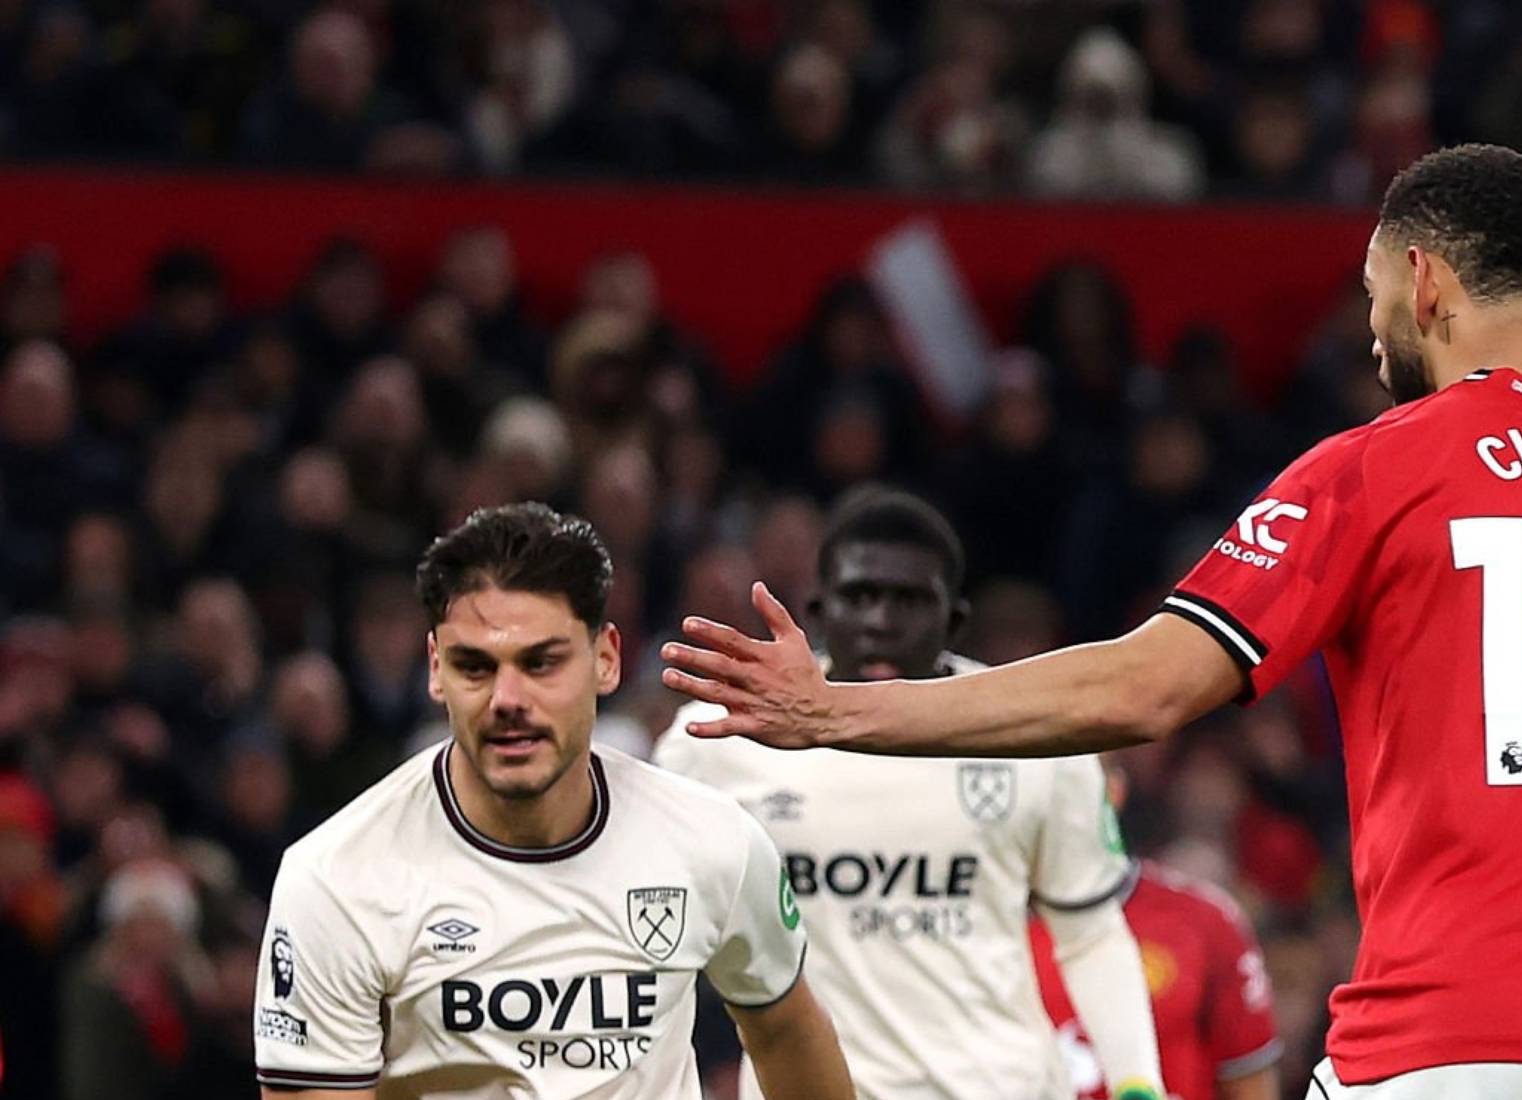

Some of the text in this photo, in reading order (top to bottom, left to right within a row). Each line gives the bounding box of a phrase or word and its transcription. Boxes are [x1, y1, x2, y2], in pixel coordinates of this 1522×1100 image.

[1213, 538, 1279, 570] OLOGY
[785, 853, 978, 896] BOYLE
[433, 941, 477, 953] umbro
[441, 974, 657, 1033] BOYLE
[517, 1036, 652, 1071] SPORTS
